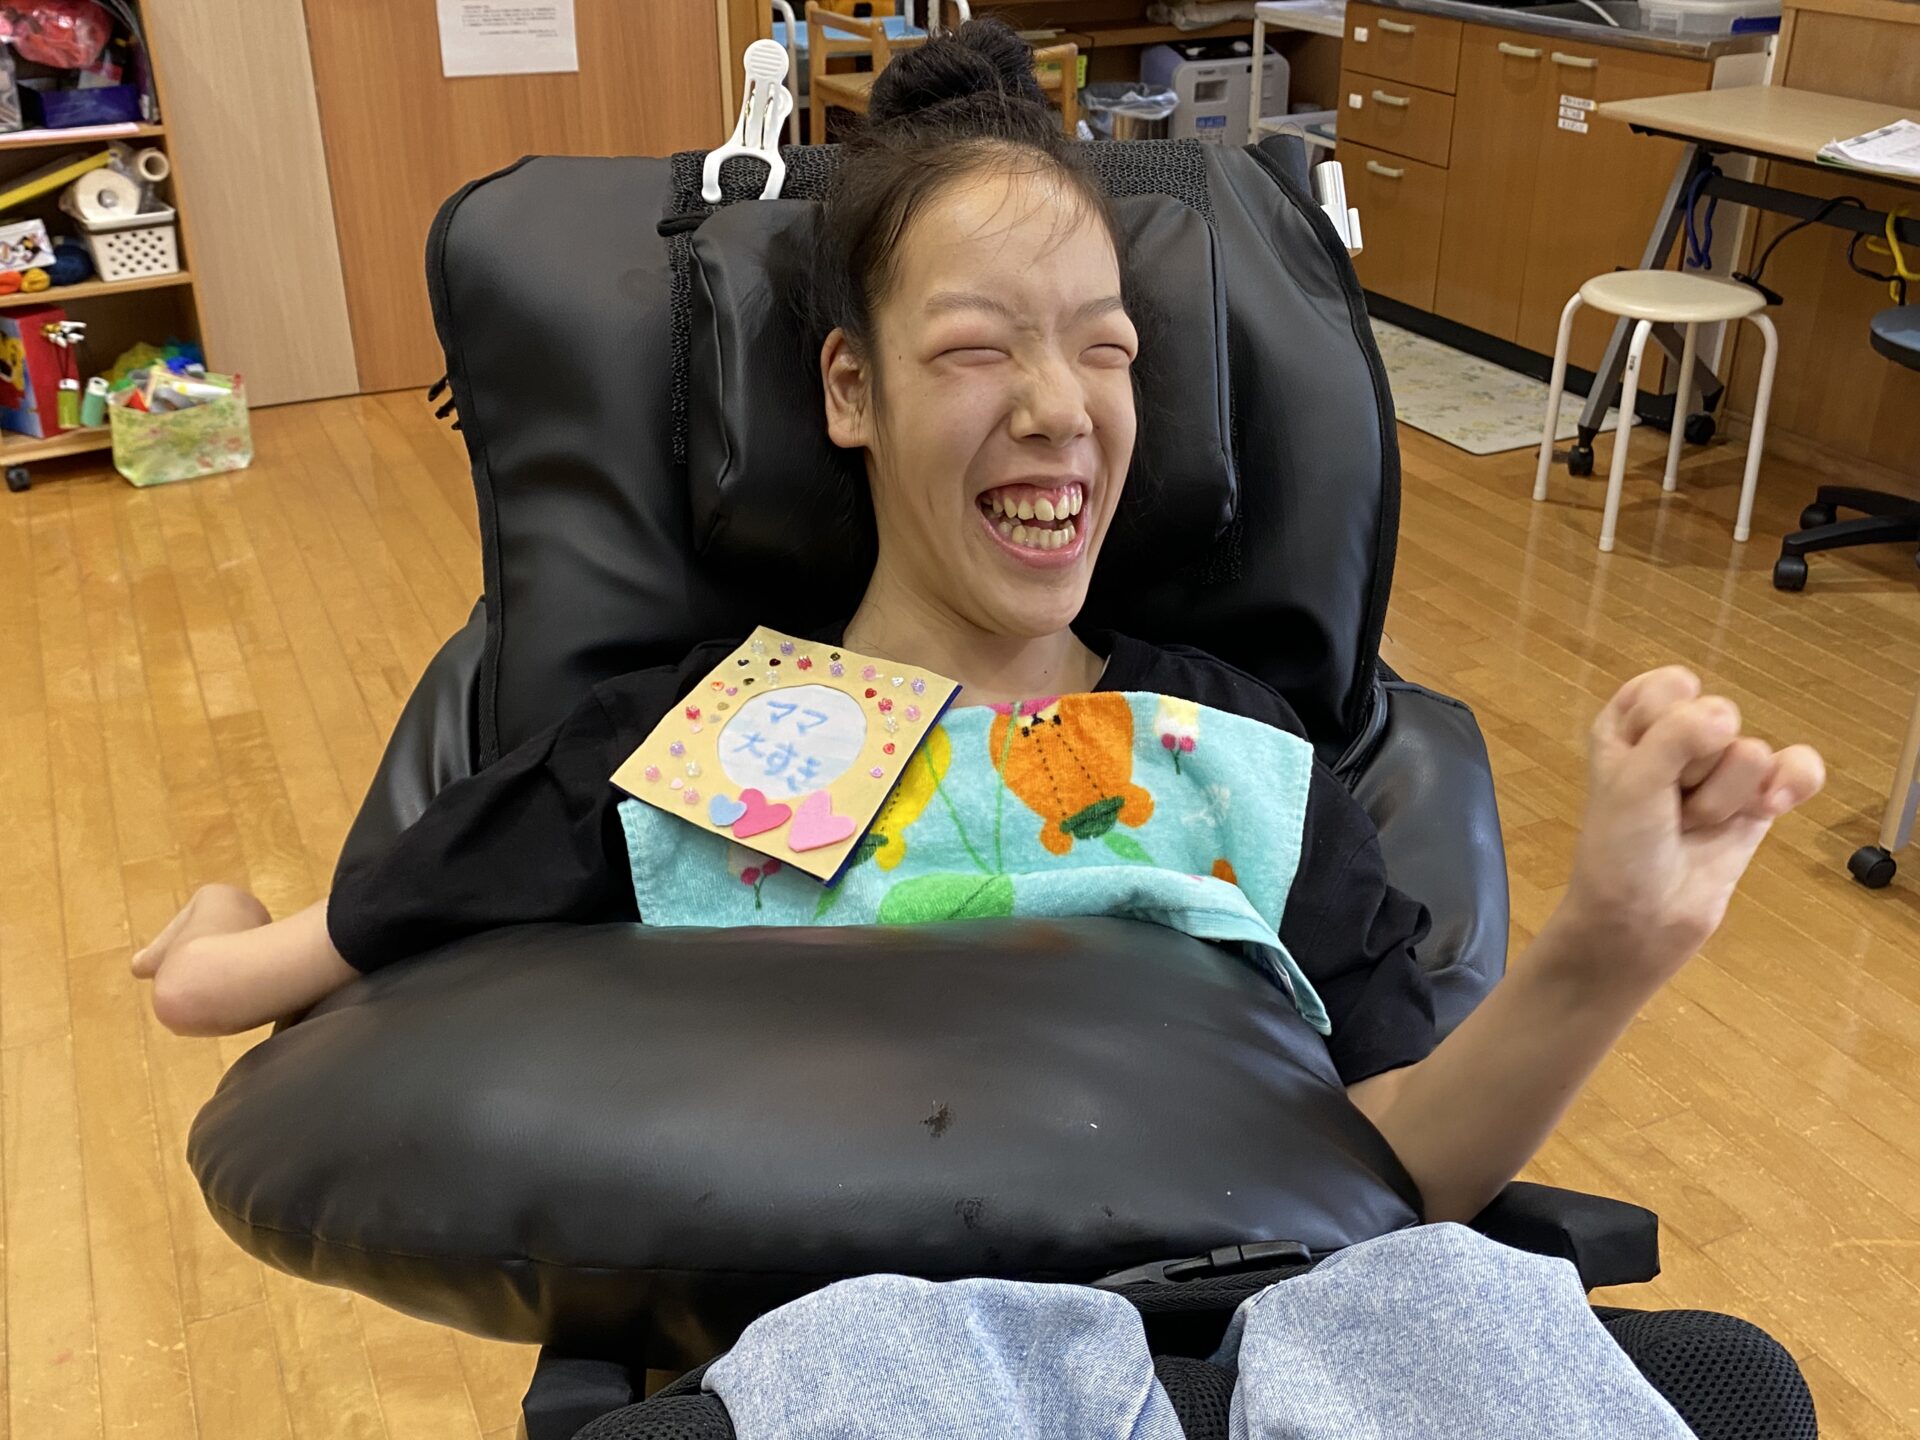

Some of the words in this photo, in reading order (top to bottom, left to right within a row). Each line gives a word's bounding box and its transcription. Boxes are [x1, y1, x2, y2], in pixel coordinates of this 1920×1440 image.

[766, 700, 829, 735] ママ
[732, 731, 822, 793] 大すき
